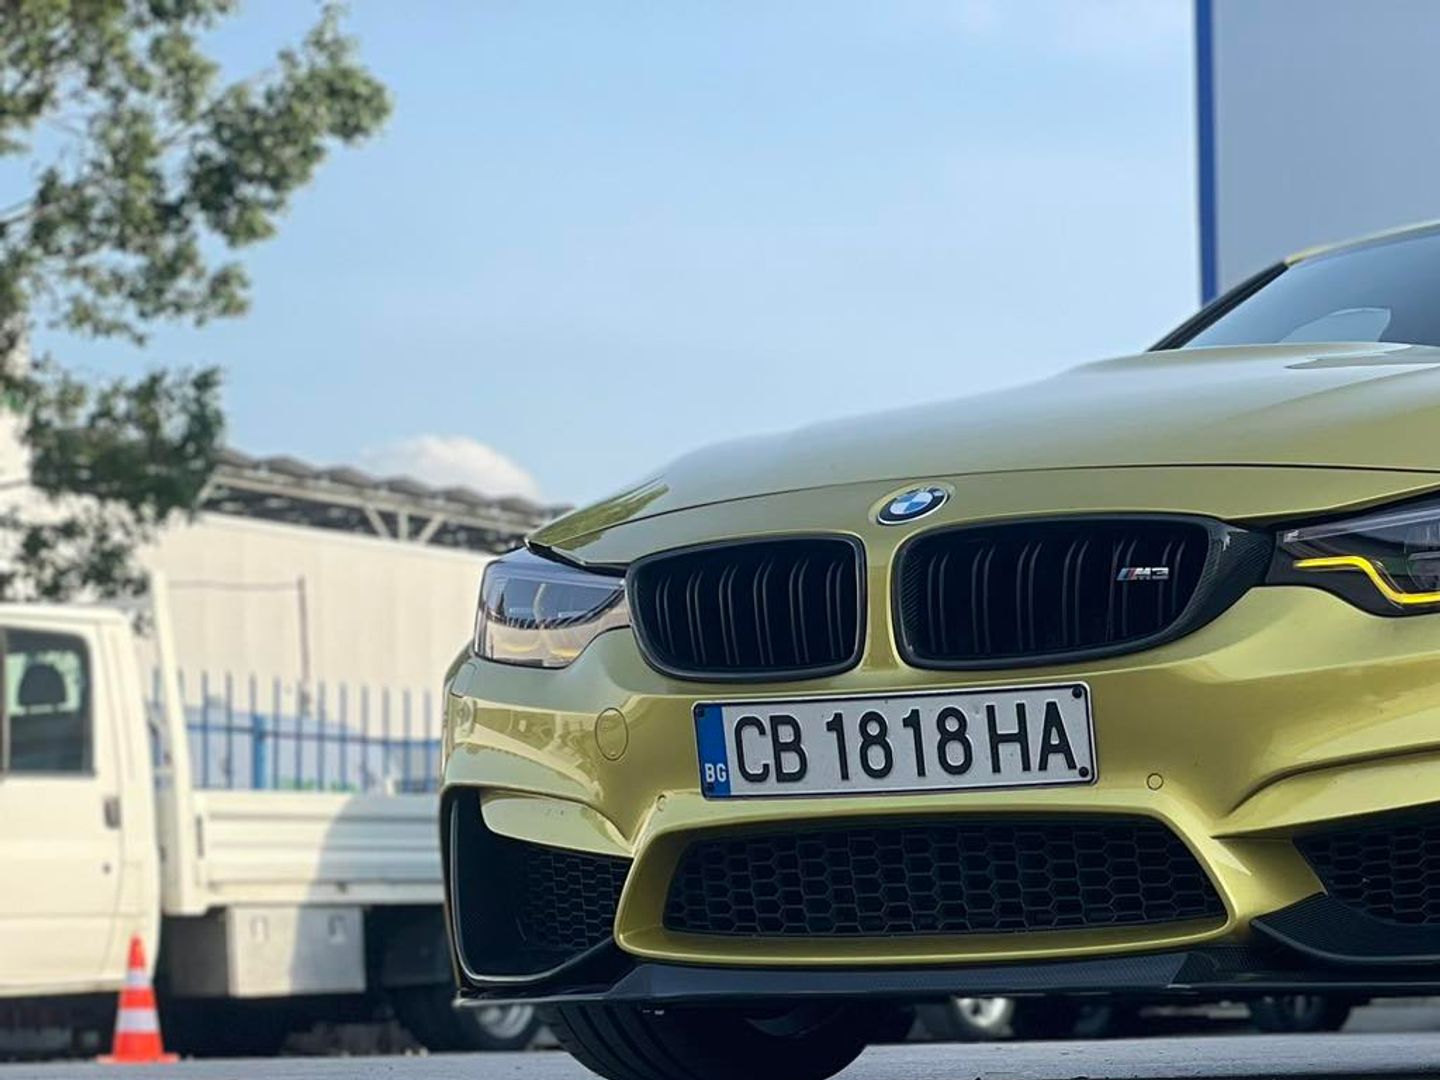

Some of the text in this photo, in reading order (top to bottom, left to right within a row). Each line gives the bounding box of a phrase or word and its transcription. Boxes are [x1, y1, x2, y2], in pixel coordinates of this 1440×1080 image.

[734, 701, 1078, 783] CB 1818 HA
[704, 763, 727, 782] BG
